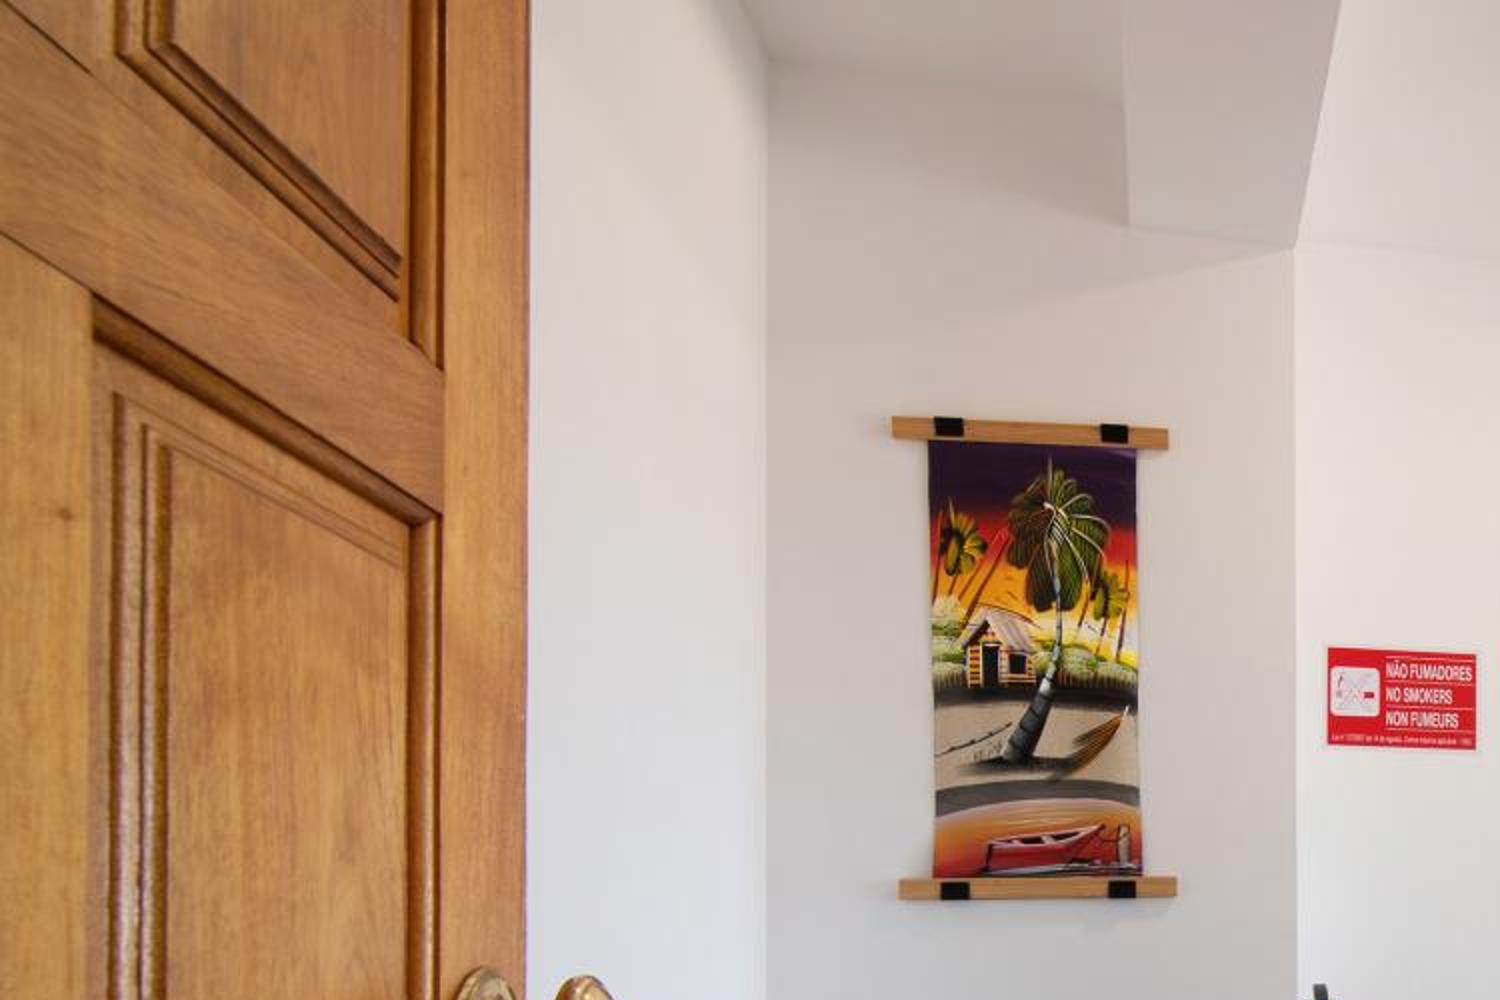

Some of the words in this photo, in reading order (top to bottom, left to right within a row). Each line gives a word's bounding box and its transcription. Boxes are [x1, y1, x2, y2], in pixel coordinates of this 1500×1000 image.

[1386, 659, 1408, 679] NÃO
[1410, 664, 1473, 682] FUMADORES
[1386, 688, 1401, 702] NO
[1404, 688, 1453, 704] SMOKERS
[1386, 711, 1409, 726] NON
[1411, 712, 1459, 729] FUMEURS
